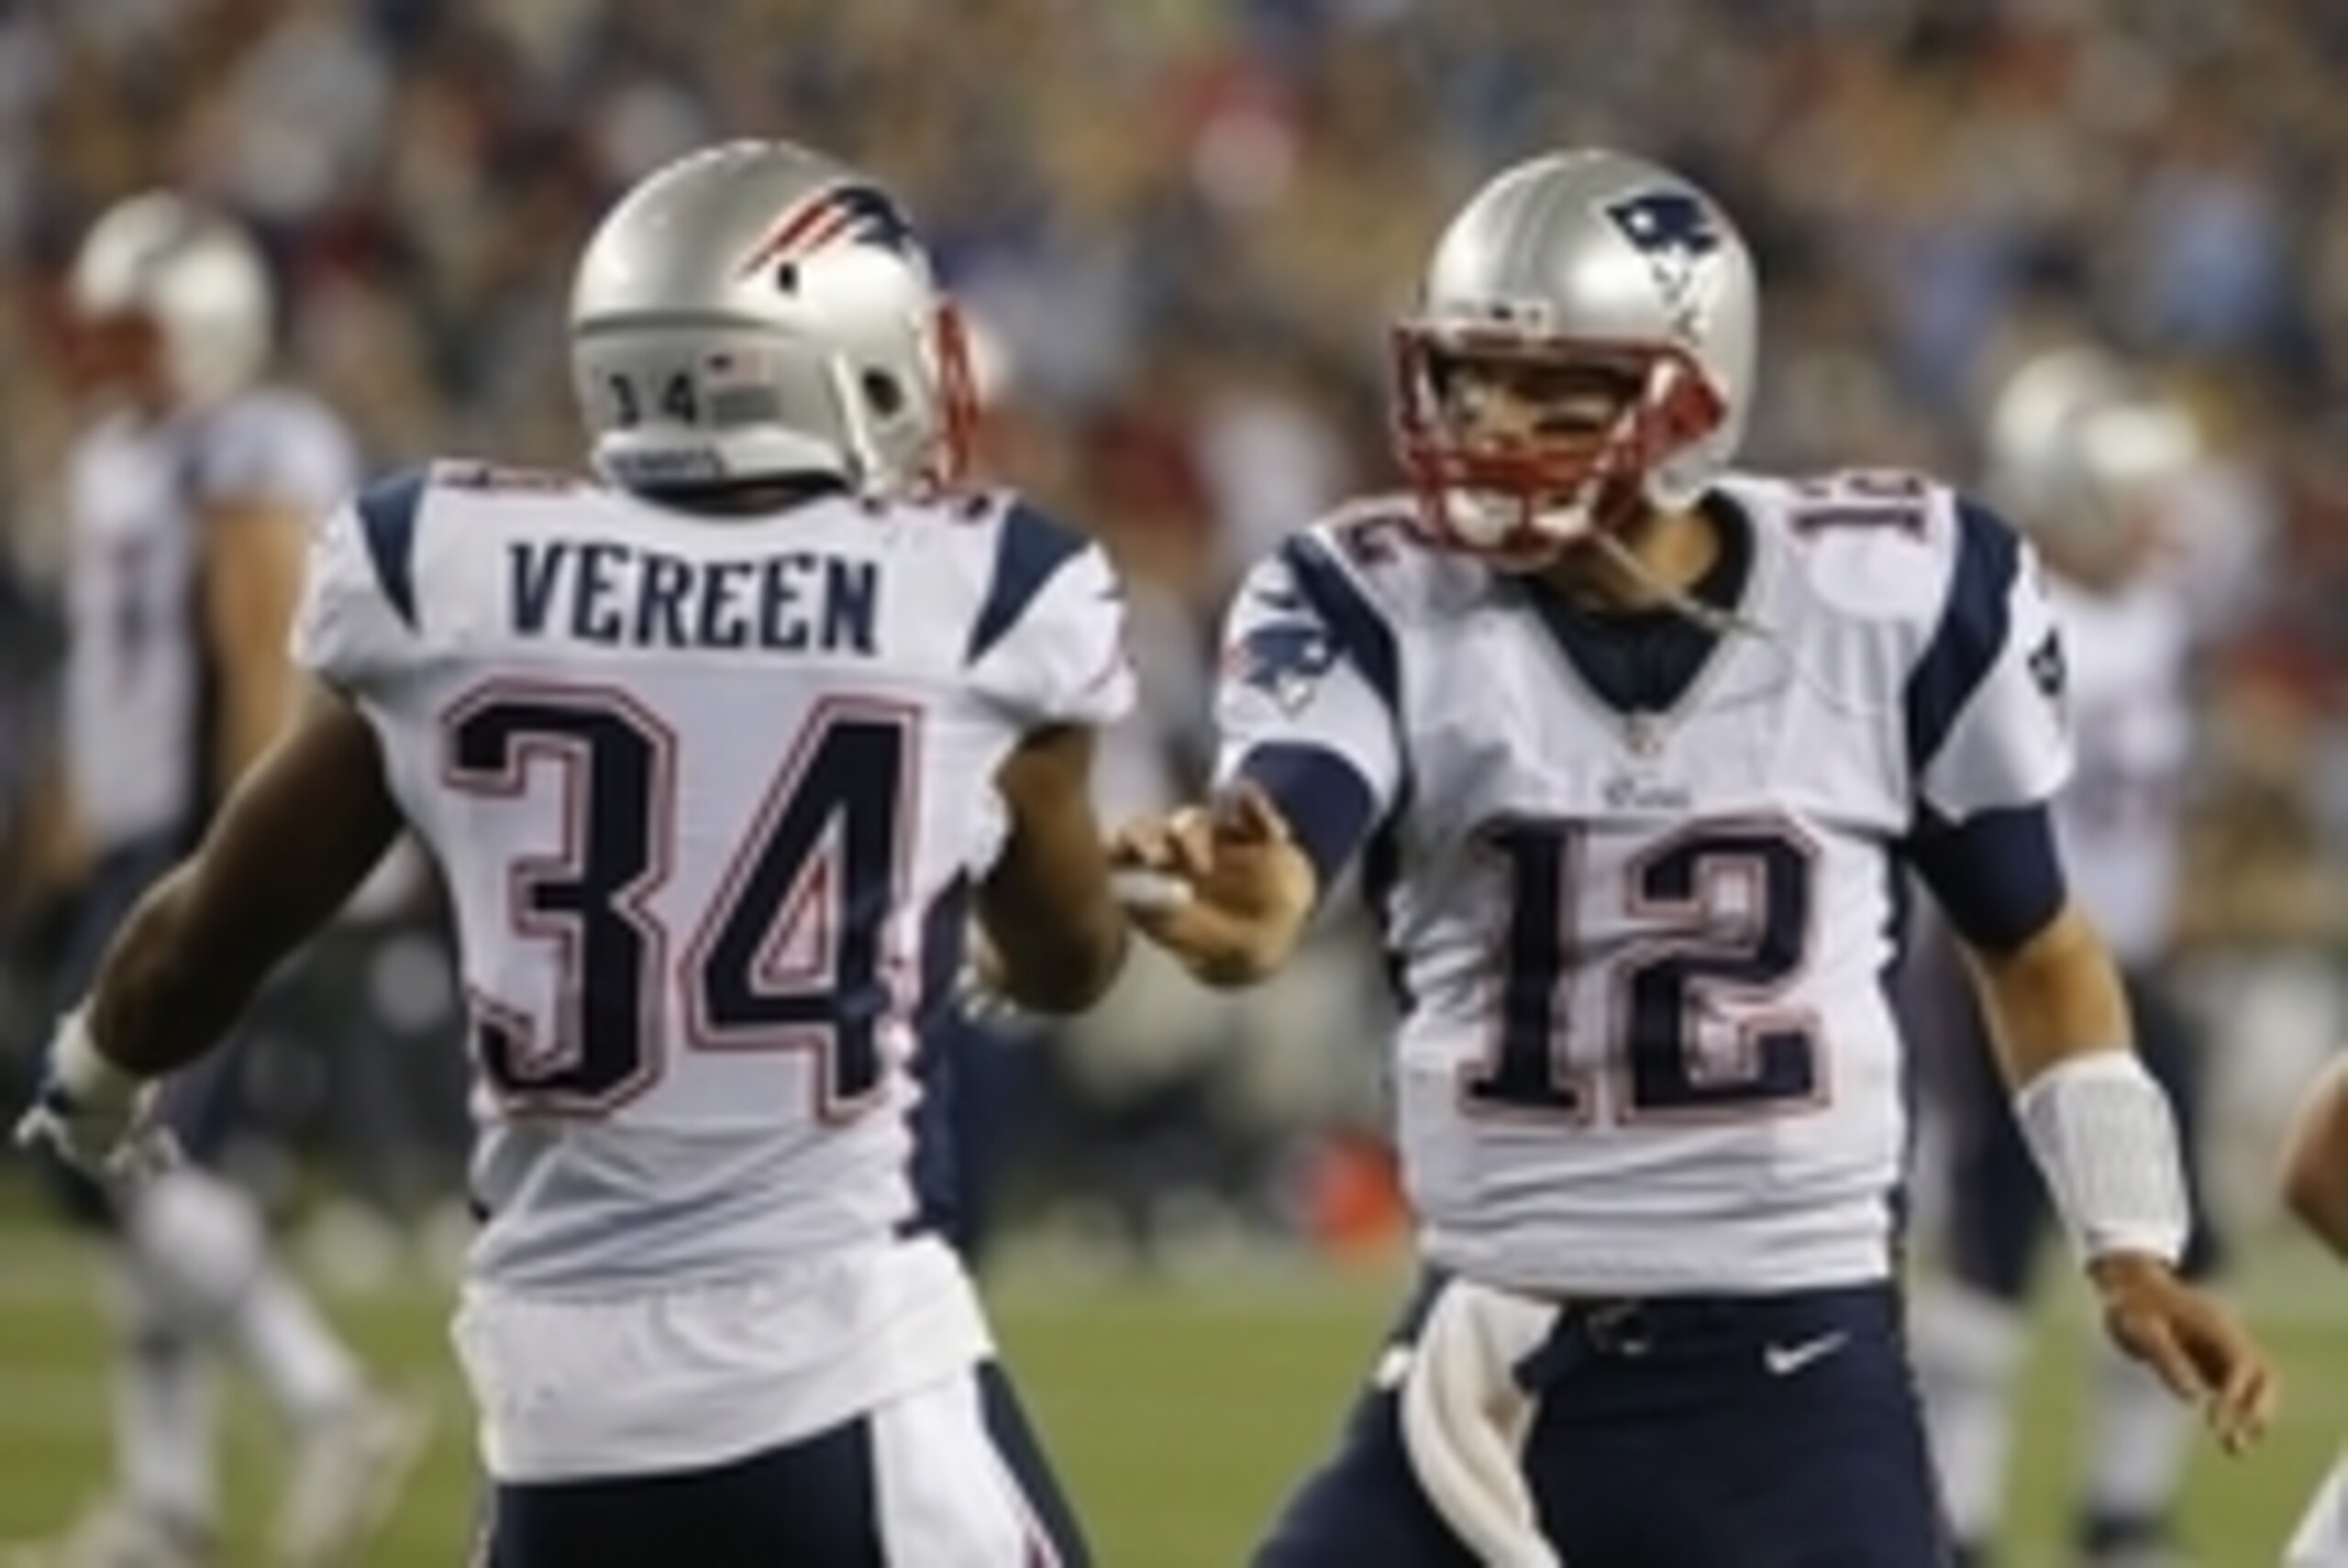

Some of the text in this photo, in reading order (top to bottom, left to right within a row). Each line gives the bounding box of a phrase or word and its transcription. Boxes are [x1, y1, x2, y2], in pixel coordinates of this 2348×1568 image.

[507, 543, 878, 655] VEREEN
[440, 679, 923, 1128] 34
[1456, 807, 1833, 1126] 12
